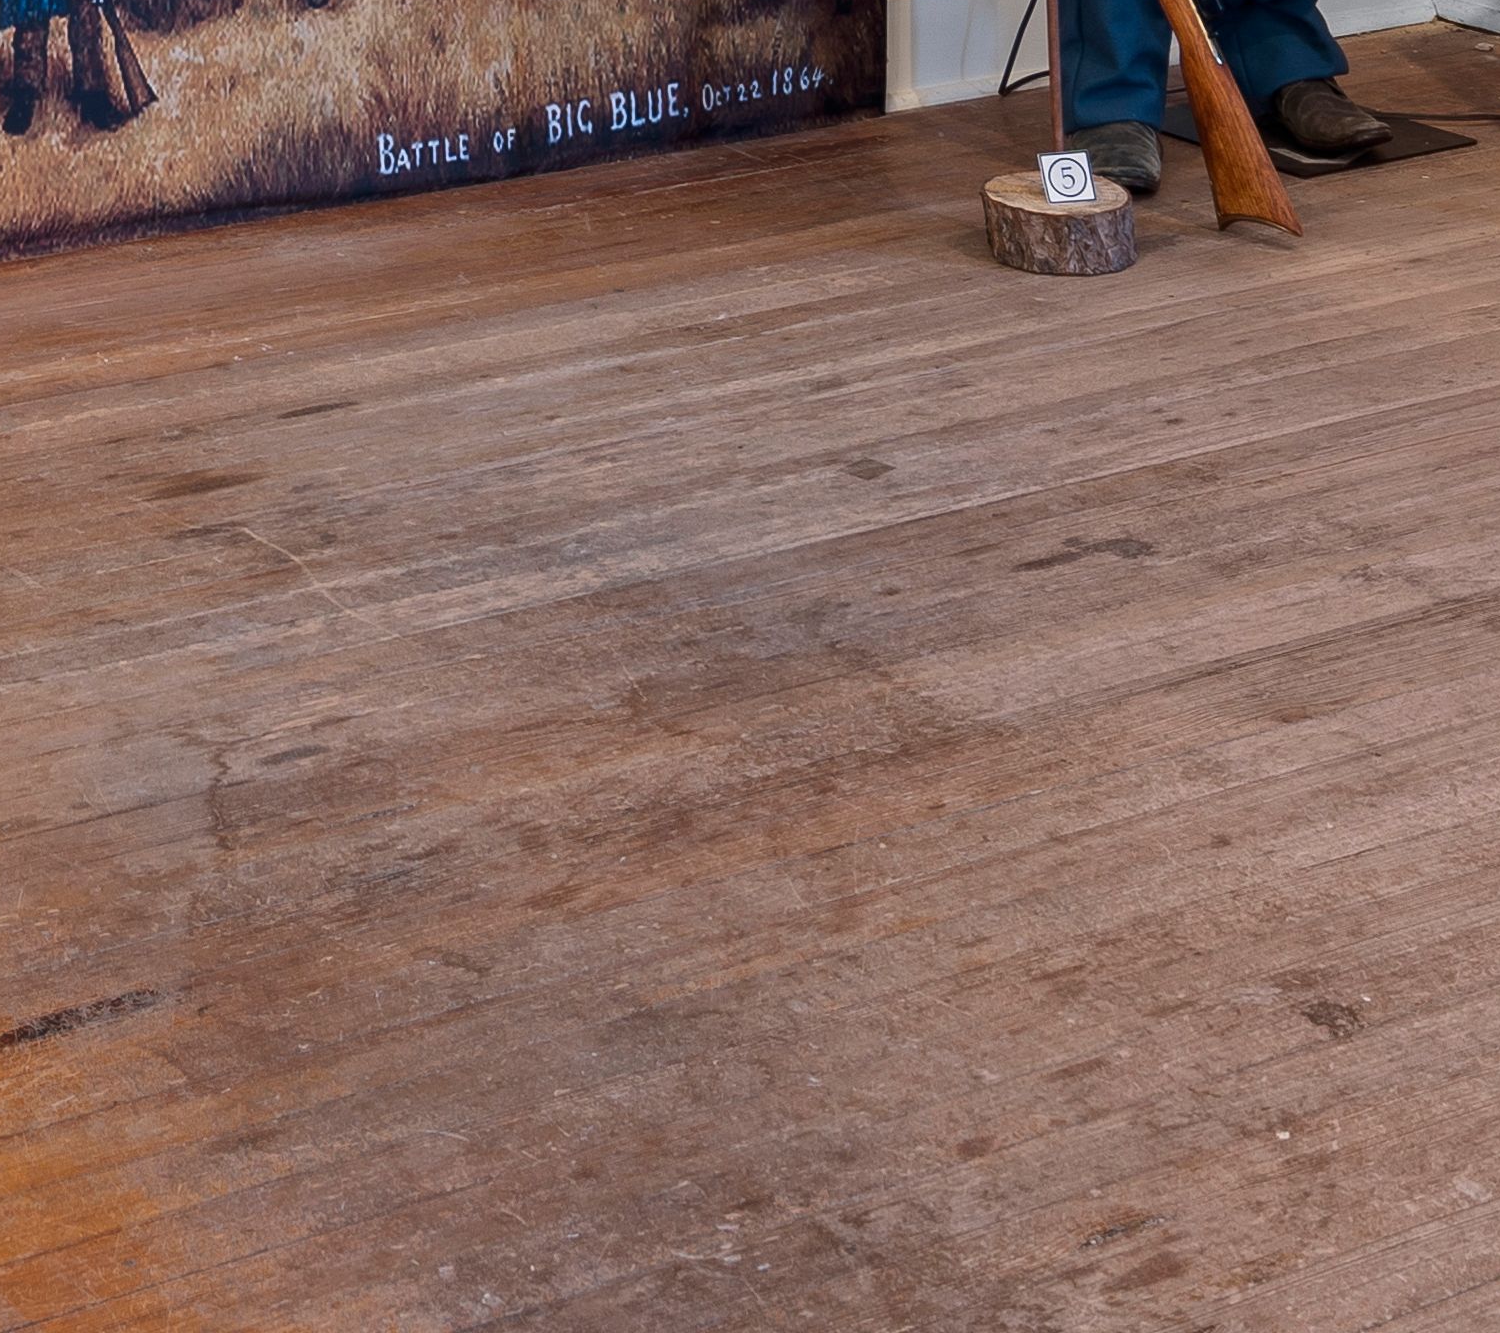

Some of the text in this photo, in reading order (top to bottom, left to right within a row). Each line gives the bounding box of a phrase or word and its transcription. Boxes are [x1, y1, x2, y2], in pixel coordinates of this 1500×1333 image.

[493, 127, 517, 153] OF
[545, 99, 593, 144] BIG
[609, 83, 689, 130] BLUE,
[737, 80, 763, 102] 22
[1060, 166, 1076, 190] 5
